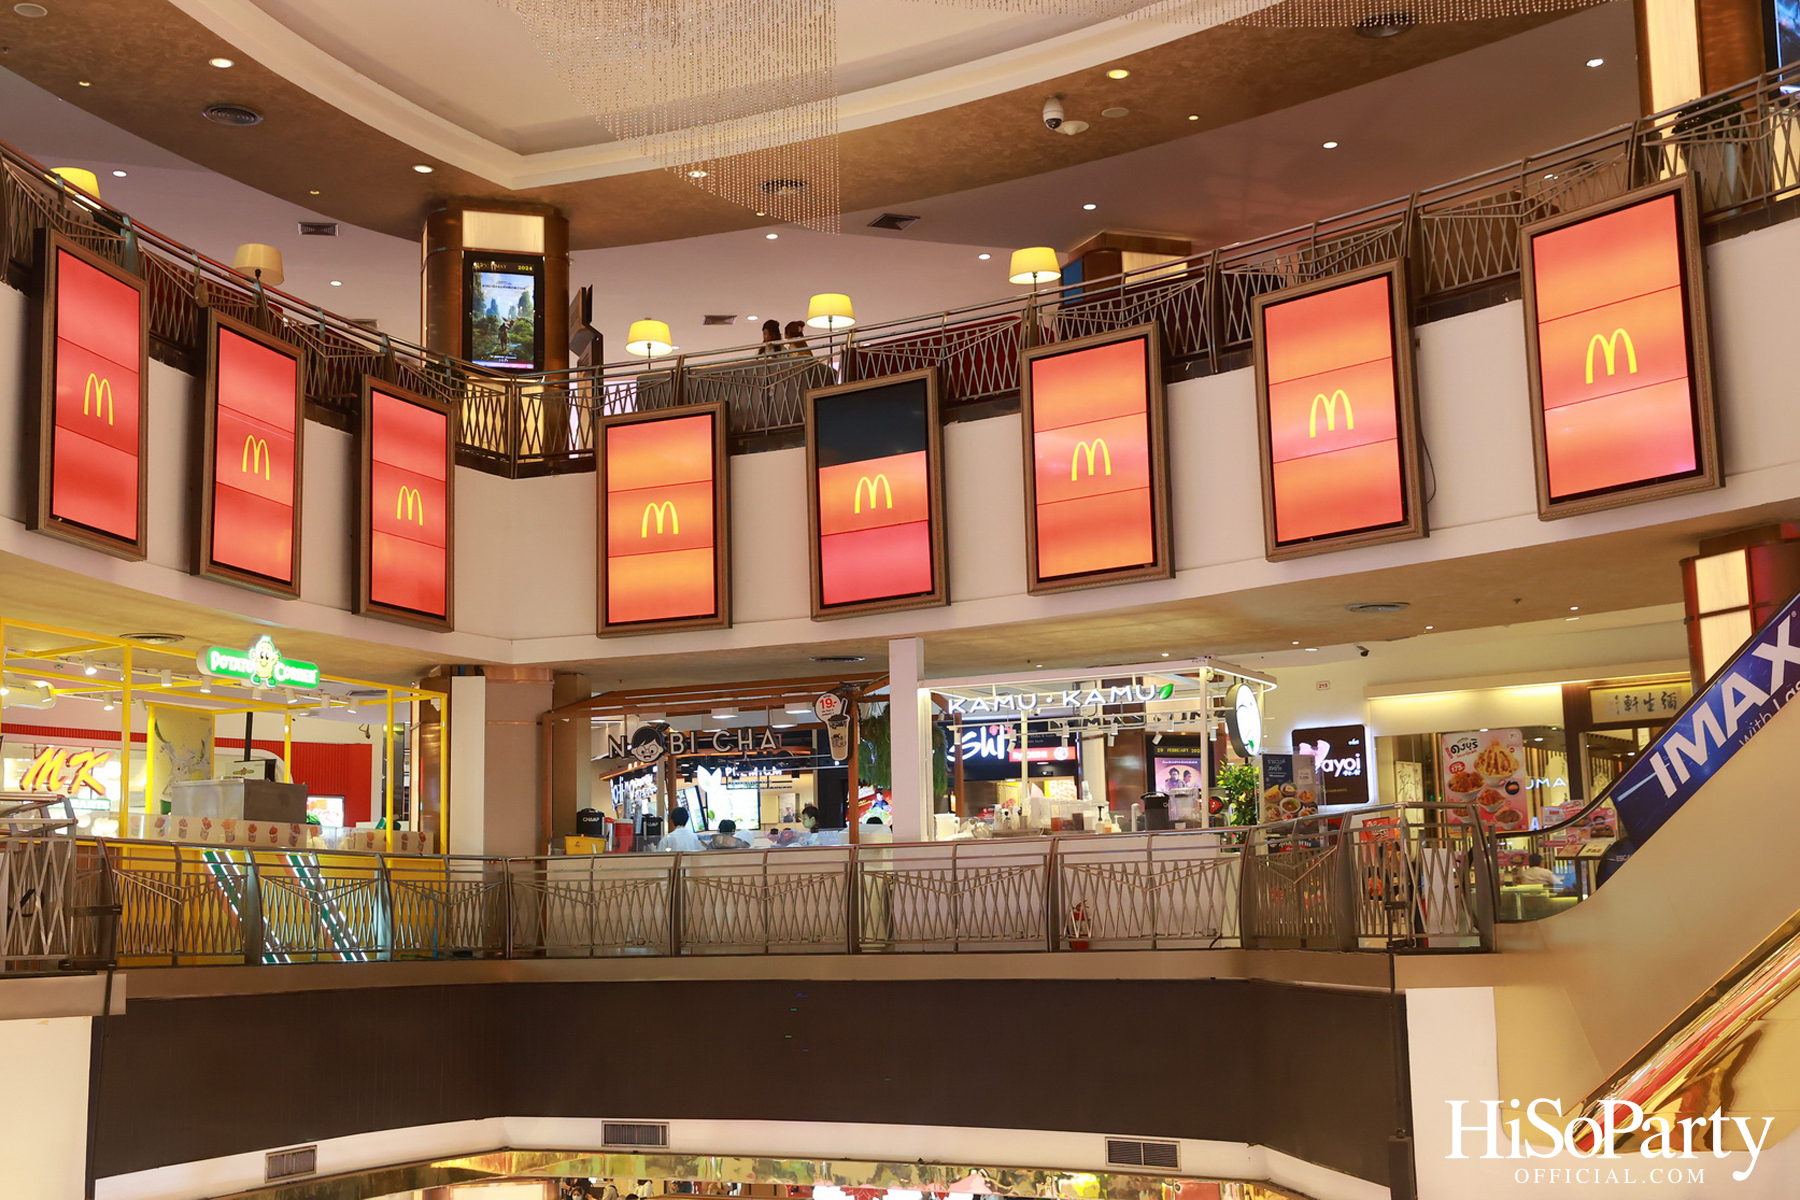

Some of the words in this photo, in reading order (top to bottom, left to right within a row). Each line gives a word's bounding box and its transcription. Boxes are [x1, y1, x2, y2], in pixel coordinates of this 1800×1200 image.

[211, 650, 256, 674] POTATO
[274, 662, 317, 685] CORNER
[948, 693, 1038, 715] KAMU
[1063, 684, 1158, 708] KAMU
[1650, 615, 1800, 798] IMAX
[712, 728, 777, 753] CHA
[20, 746, 112, 796] MK
